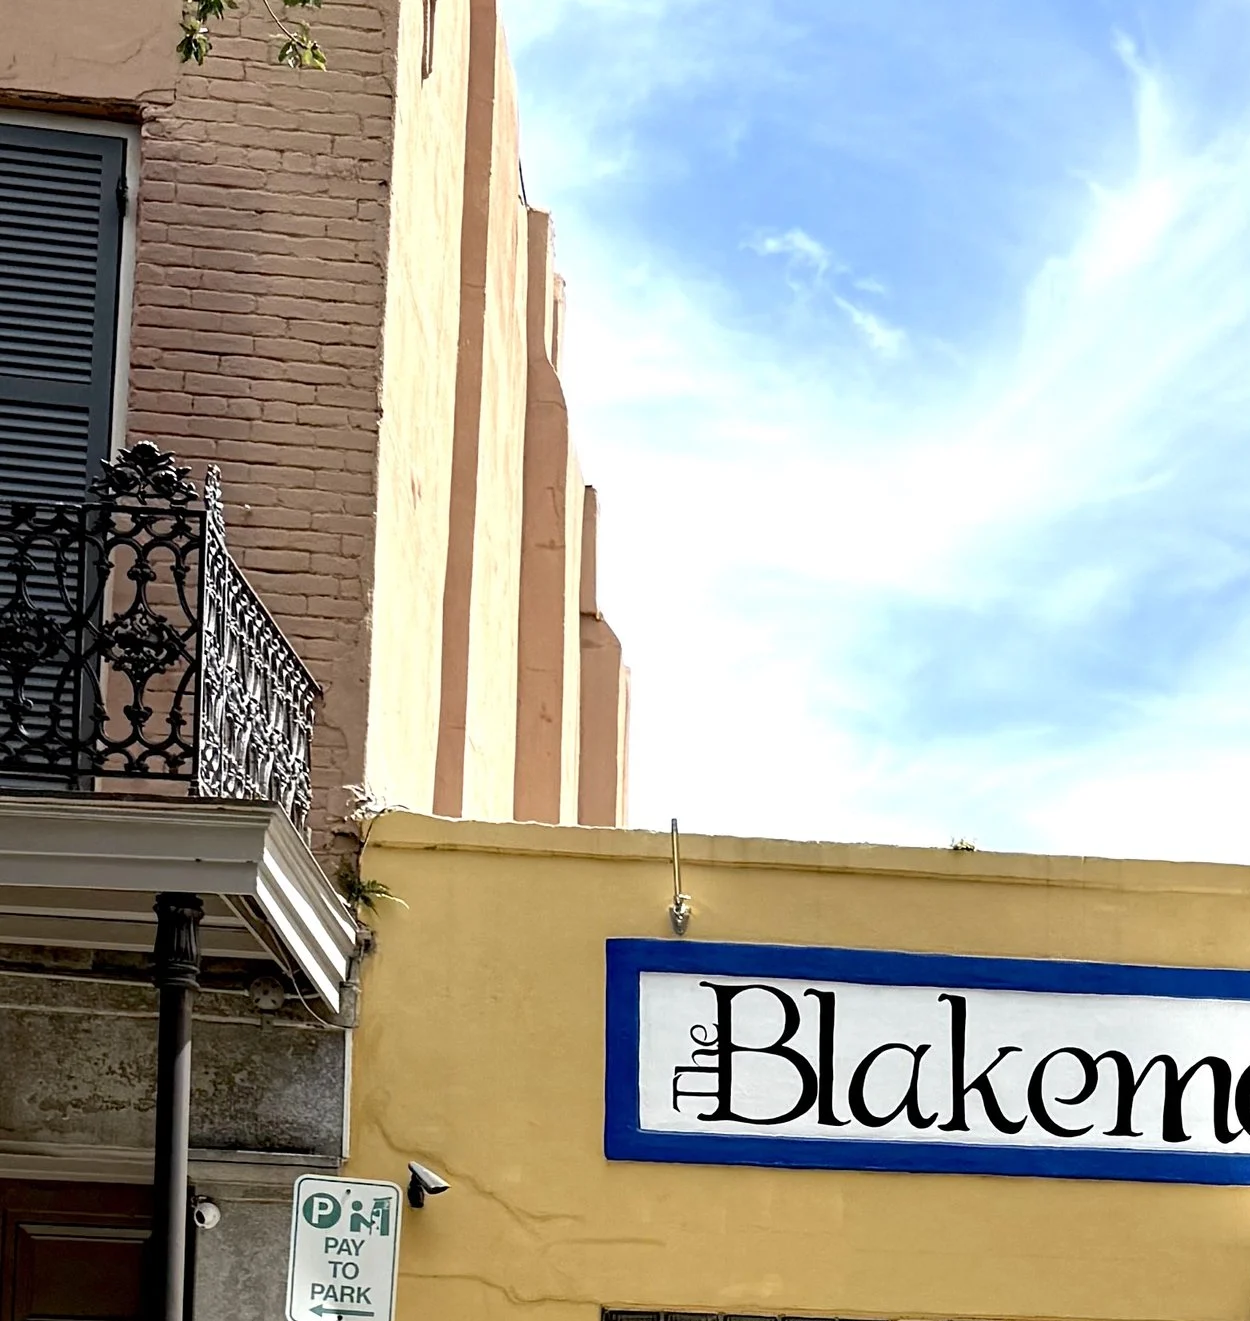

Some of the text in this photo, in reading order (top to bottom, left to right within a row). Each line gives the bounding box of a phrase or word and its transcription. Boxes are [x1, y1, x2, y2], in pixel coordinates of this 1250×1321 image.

[672, 1022, 719, 1113] The
[324, 1237, 366, 1257] PAY
[328, 1261, 360, 1280] TO
[311, 1283, 372, 1305] PARK
